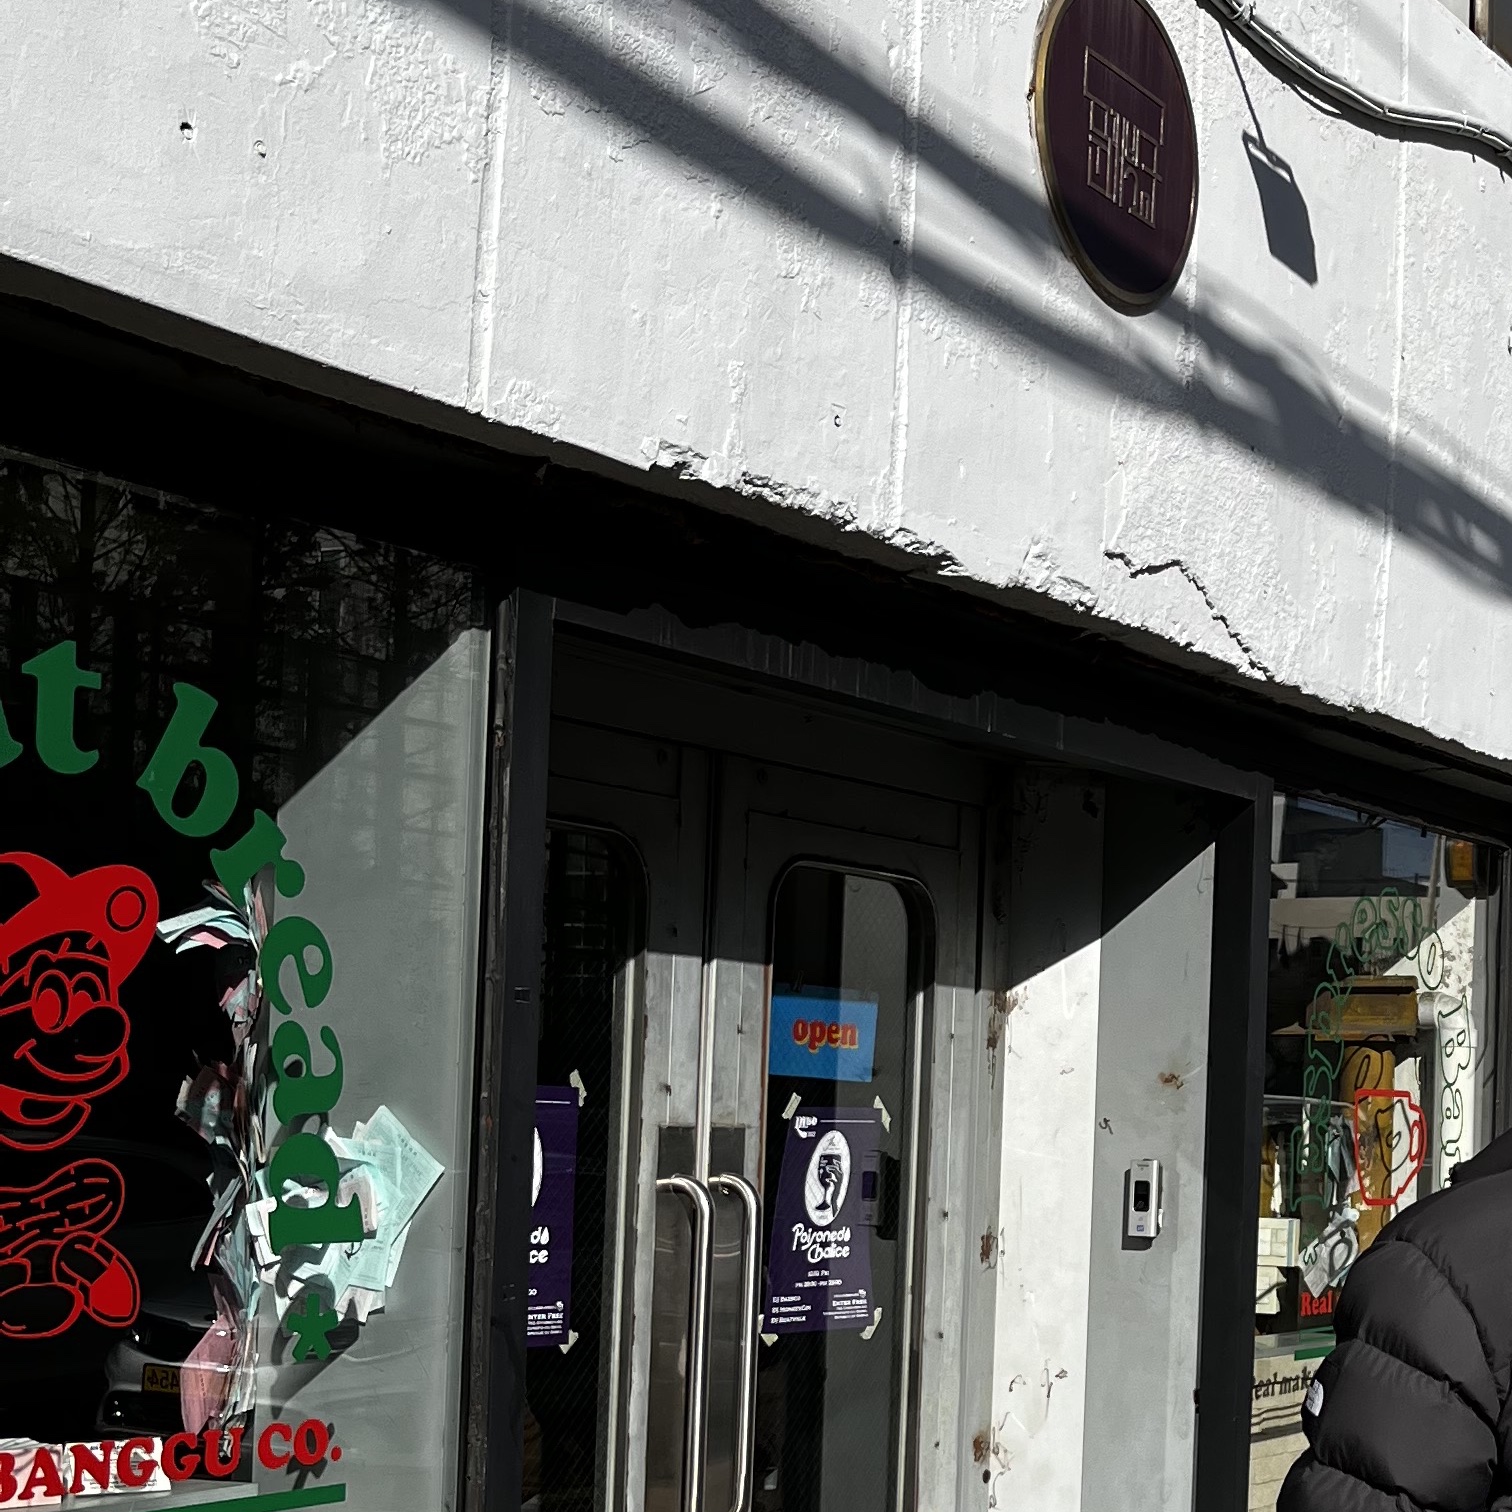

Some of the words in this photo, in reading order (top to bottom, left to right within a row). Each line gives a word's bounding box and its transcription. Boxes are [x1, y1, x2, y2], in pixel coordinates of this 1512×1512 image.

[0, 640, 101, 774] t
[136, 682, 365, 1257] bread
[793, 1018, 859, 1053] open
[791, 1222, 847, 1251] Poisoned
[1300, 1291, 1333, 1317] Real
[257, 1418, 343, 1470] CO.
